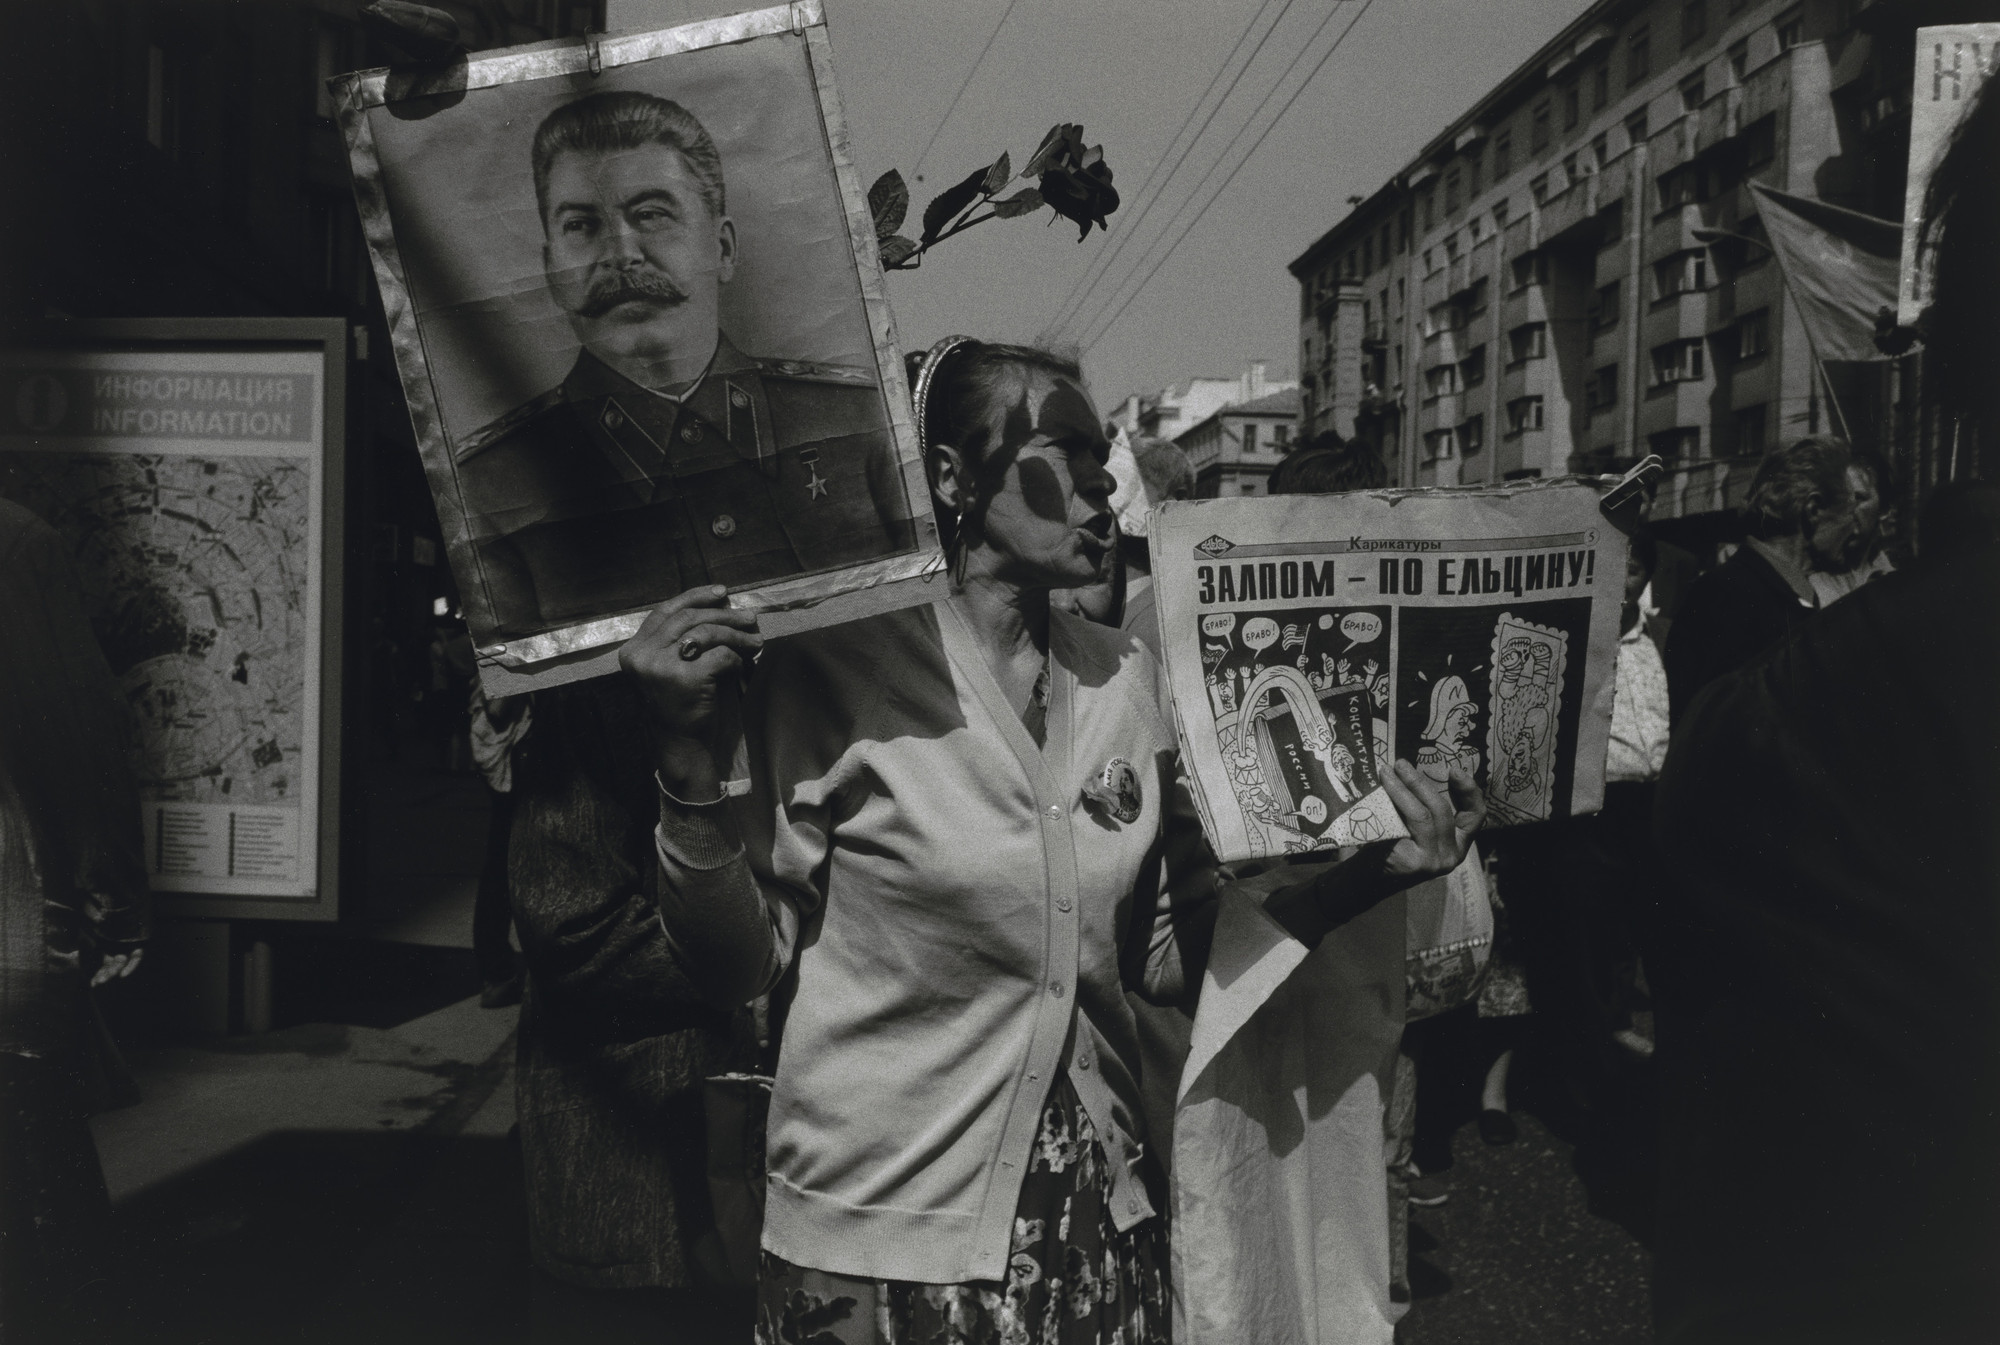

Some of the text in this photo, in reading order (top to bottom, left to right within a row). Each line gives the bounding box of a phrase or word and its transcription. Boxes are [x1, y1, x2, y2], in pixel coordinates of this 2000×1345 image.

[96, 377, 293, 404] ИНФОРМАЦИЯ
[94, 408, 292, 436] INFORMATION
[1349, 536, 1442, 553] Карикатуры
[1197, 560, 1335, 605] ЗАЛПОМ
[1379, 558, 1423, 596] ПО
[1437, 550, 1596, 598] ЕЛЬЦИНУ!
[1205, 616, 1232, 632] БРАВО!
[1245, 623, 1275, 642] БРАВО!
[1343, 620, 1379, 633] БРАВО!
[1349, 695, 1377, 788] КОНСТИТУЦИЯ
[1284, 743, 1311, 790] РОССИИ
